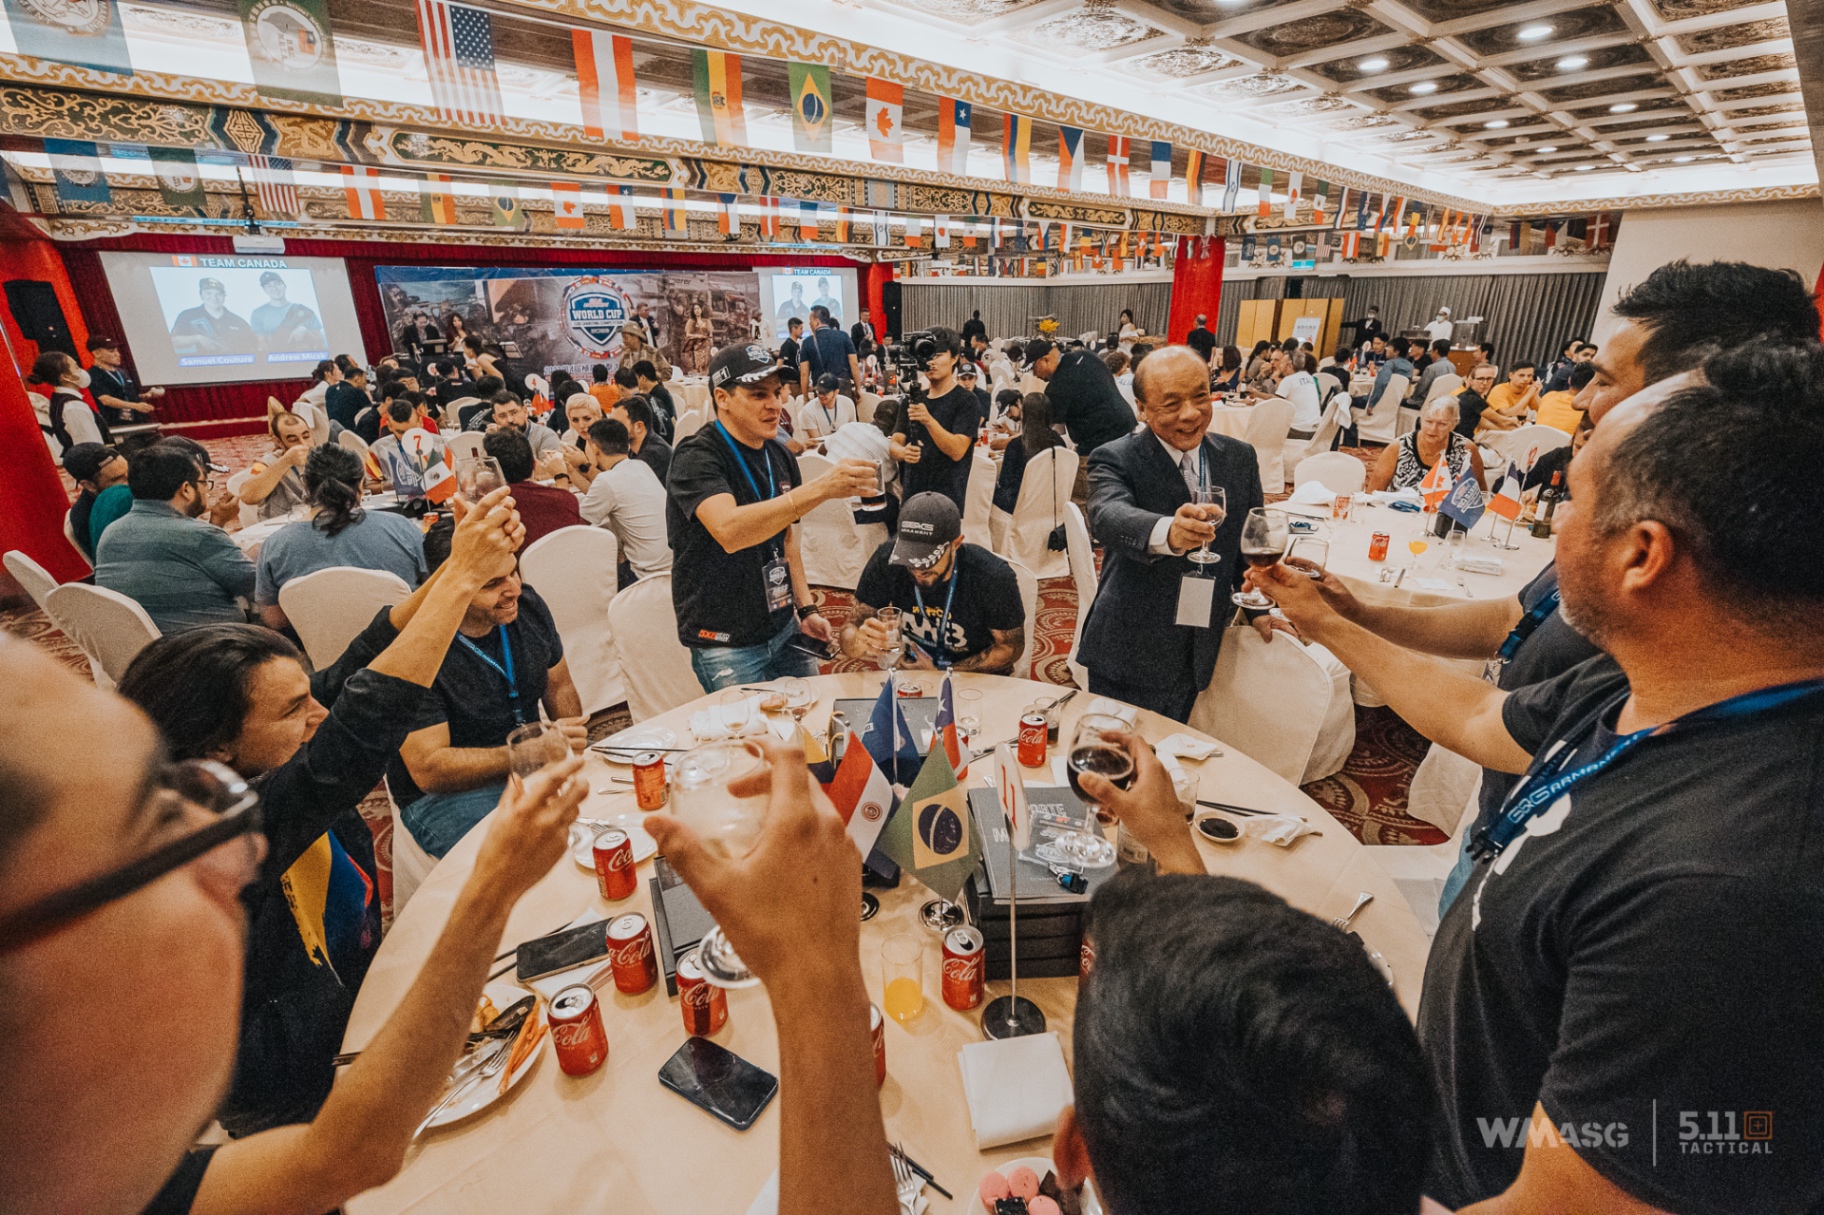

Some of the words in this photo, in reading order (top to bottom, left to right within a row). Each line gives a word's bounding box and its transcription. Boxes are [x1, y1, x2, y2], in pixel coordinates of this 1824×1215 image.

[200, 257, 235, 268] TEAM
[237, 258, 288, 269] CANADA
[572, 310, 604, 320] WORLD
[606, 309, 622, 319] CUP
[181, 356, 216, 366] Samuel
[216, 354, 254, 365] Couture
[268, 353, 302, 363] Andrew
[531, 378, 537, 387] 4
[413, 435, 422, 450] 7
[1020, 727, 1044, 745] Cola
[942, 957, 981, 981] Cola
[552, 1011, 593, 1046] Cola
